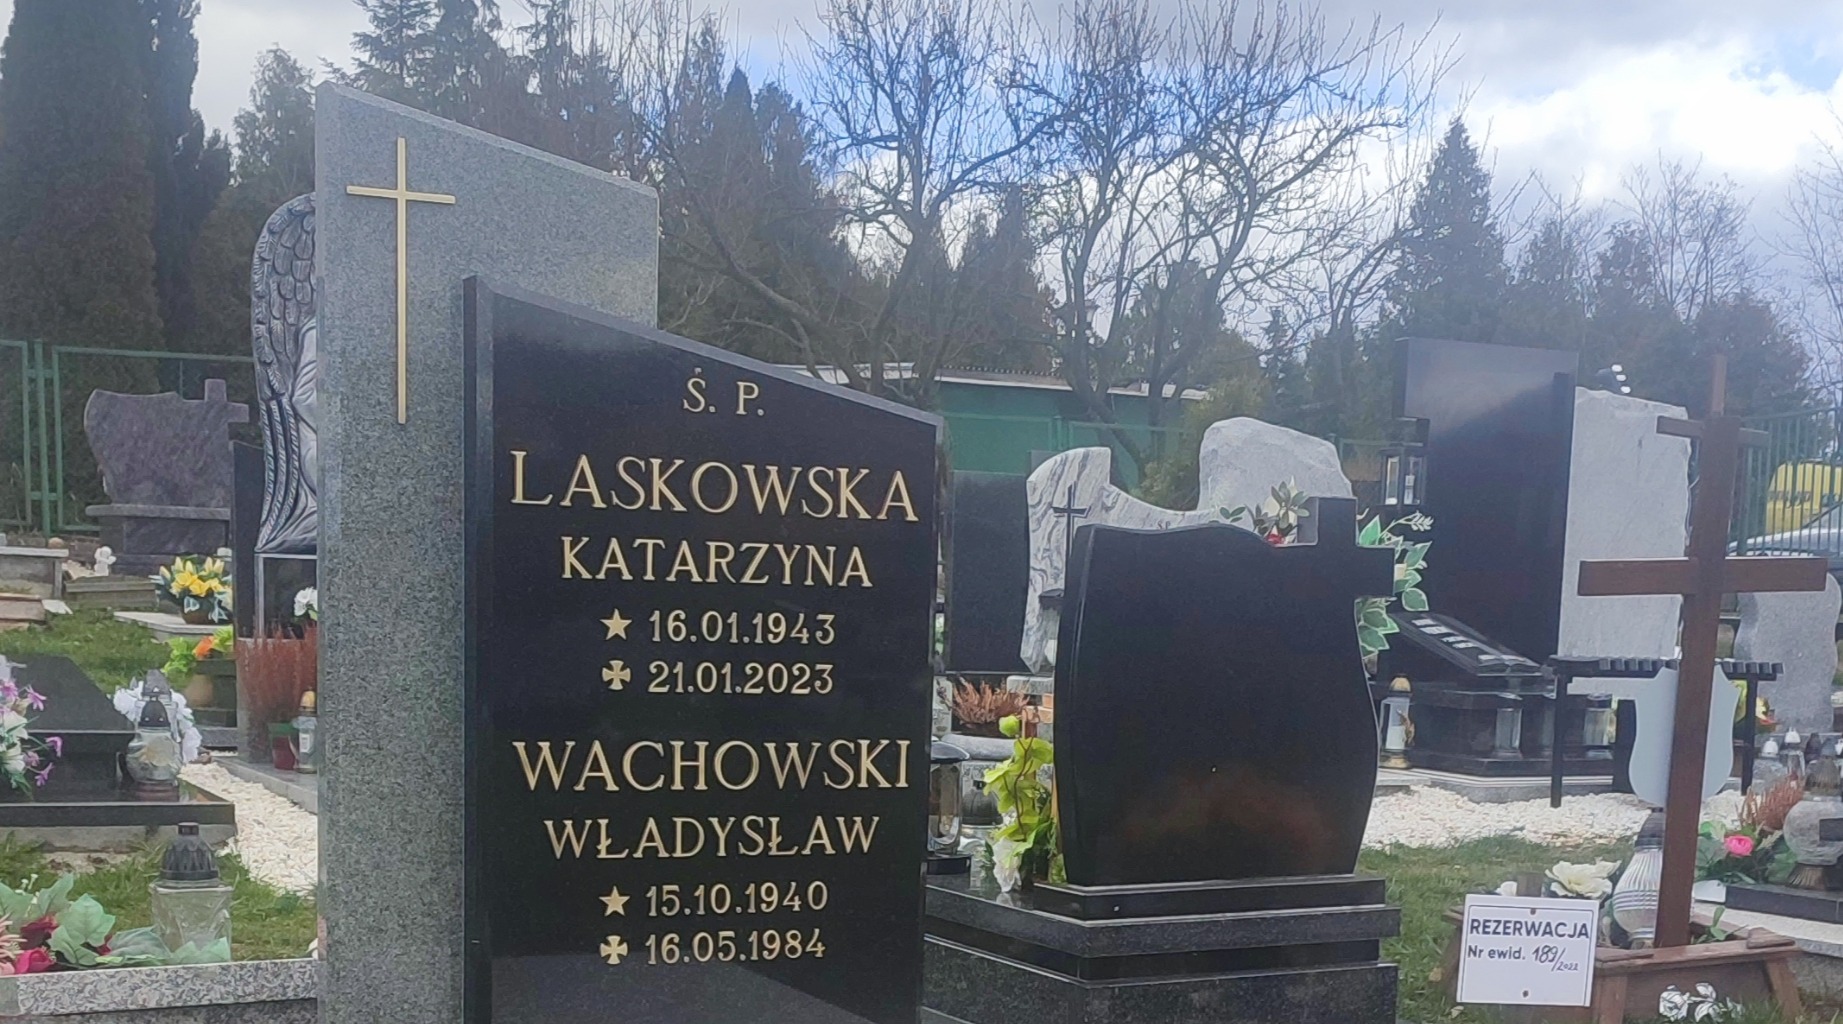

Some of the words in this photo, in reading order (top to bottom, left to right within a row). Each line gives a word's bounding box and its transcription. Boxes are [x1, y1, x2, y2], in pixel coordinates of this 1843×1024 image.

[683, 367, 716, 413] Ś.
[735, 381, 765, 416] P.
[510, 450, 919, 522] LASKOWSKA
[561, 536, 873, 588] KATARZYNA
[648, 609, 836, 645] 16.01.1943
[647, 660, 834, 695] 21.01.2023
[512, 739, 911, 791] WACHOWSKI
[543, 815, 880, 860] WŁADYSŁAW
[645, 880, 828, 917] 15.10.1940
[645, 928, 826, 965] 16.05.1984
[1469, 918, 1590, 939] REZERWACJA
[1467, 944, 1484, 958] Nr
[1487, 946, 1526, 960] ewid.
